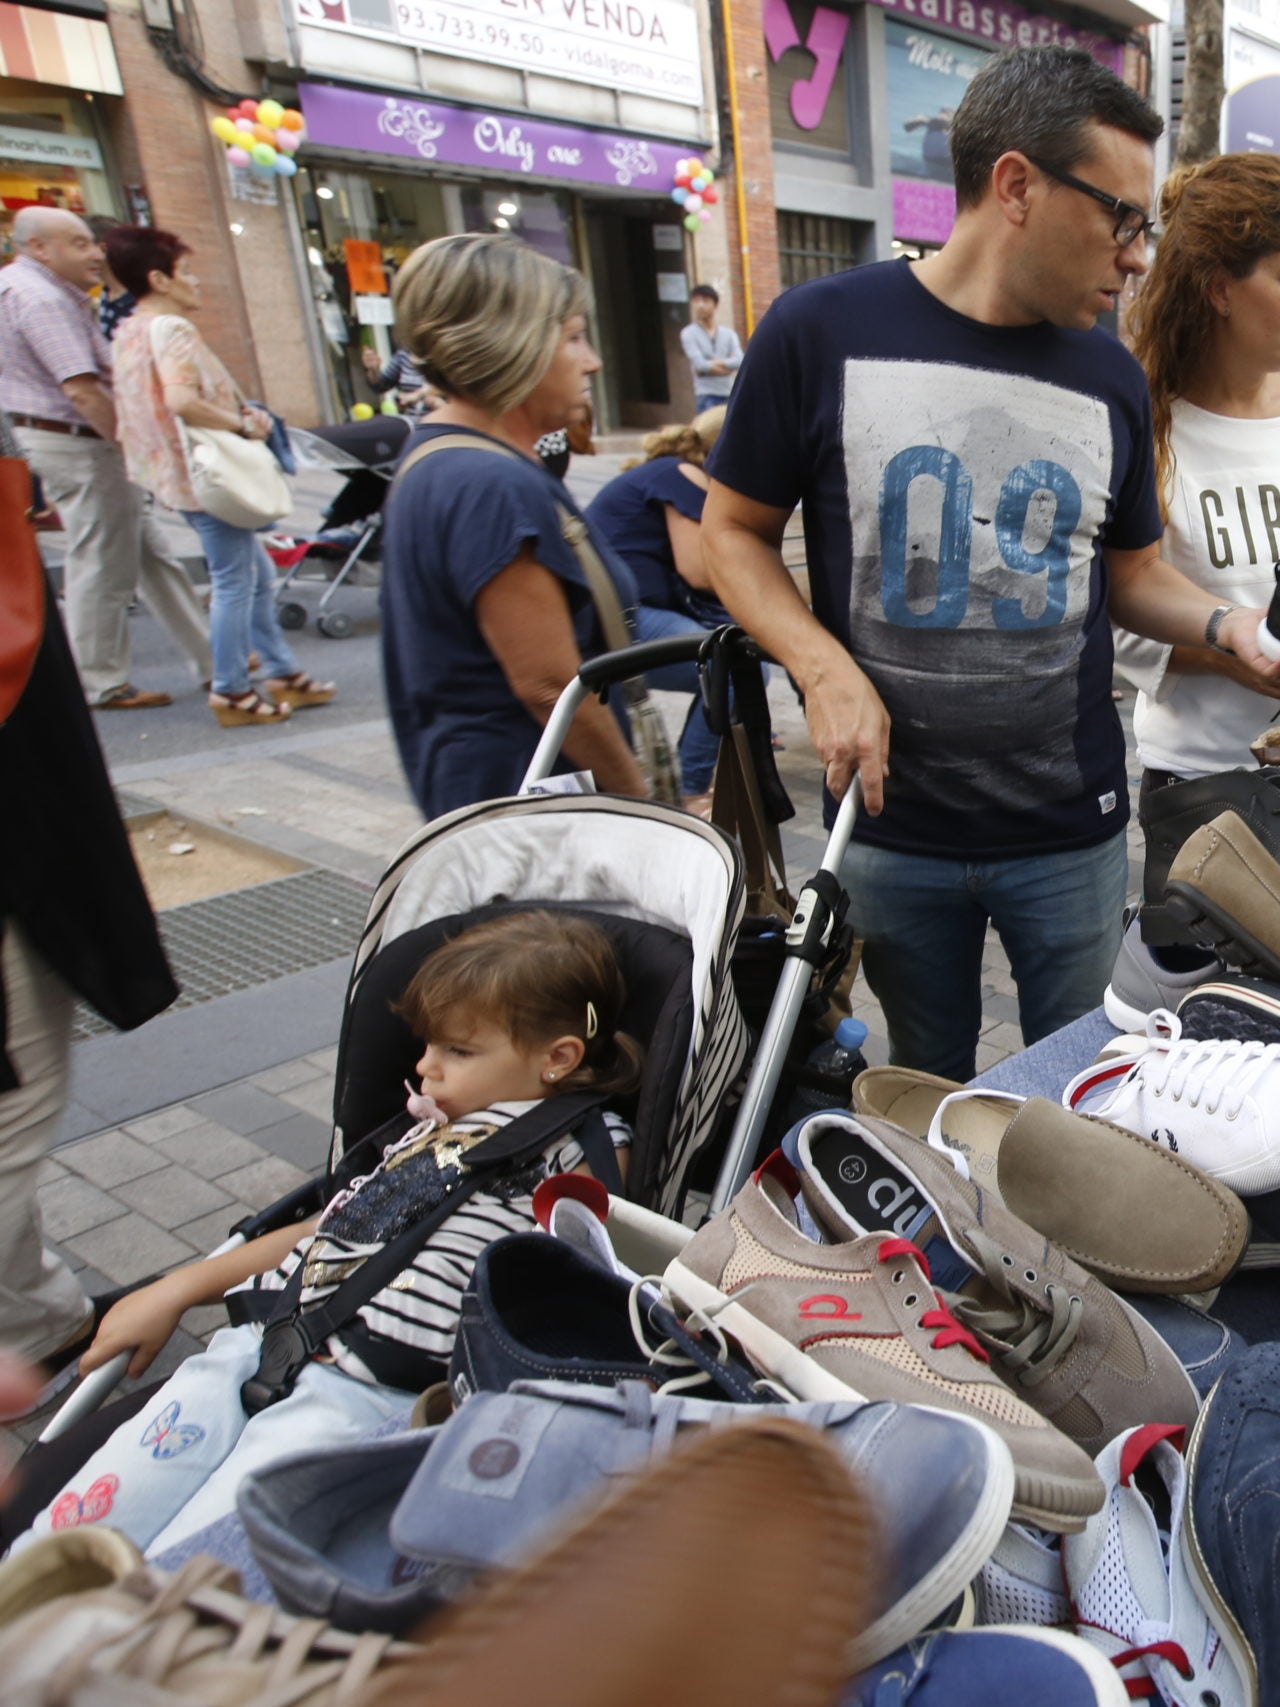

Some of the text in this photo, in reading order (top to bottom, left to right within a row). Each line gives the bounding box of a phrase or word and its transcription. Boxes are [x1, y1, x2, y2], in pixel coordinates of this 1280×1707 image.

[398, 5, 544, 55] 93.733.99.50
[562, 0, 668, 45] VENDA
[473, 116, 582, 172] Only one
[880, 445, 1082, 630] 09
